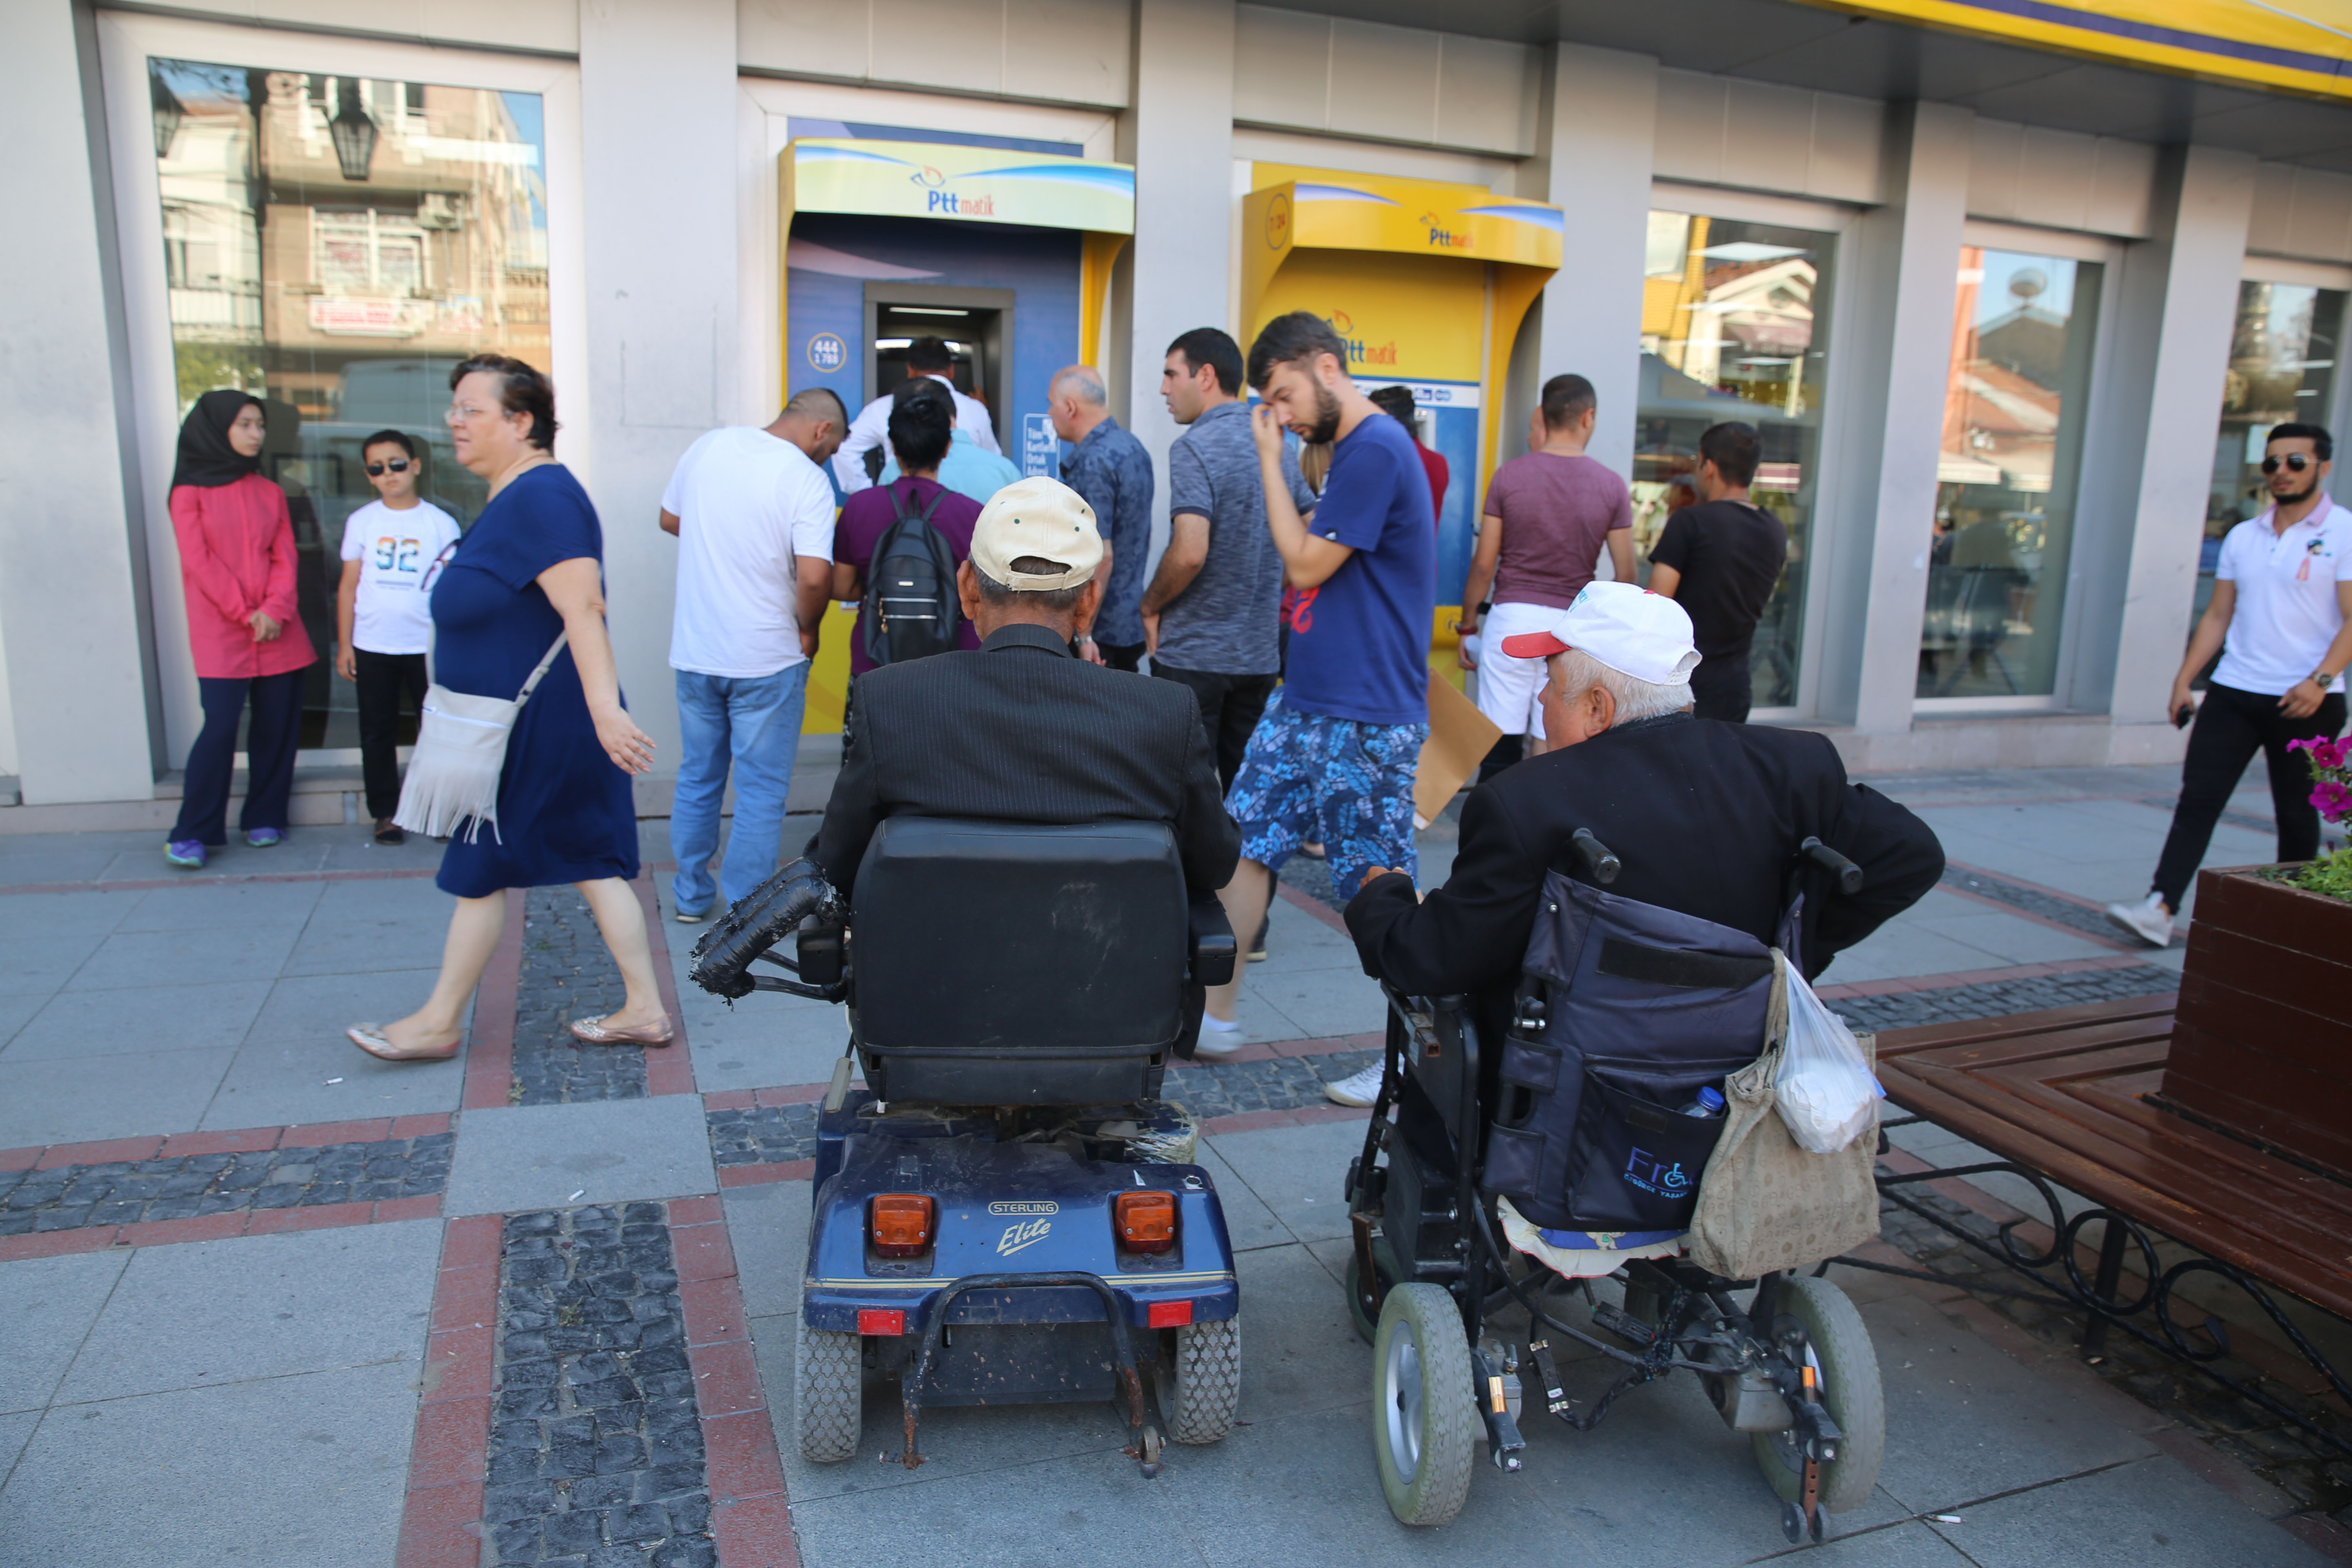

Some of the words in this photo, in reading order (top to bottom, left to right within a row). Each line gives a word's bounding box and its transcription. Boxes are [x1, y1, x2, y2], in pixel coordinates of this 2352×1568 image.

[928, 190, 959, 213] Ptt
[1430, 228, 1451, 246] Ptt
[814, 340, 838, 352] 444
[376, 537, 421, 572] 92
[993, 1204, 1054, 1213] STERLING
[996, 1218, 1051, 1253] Elite
